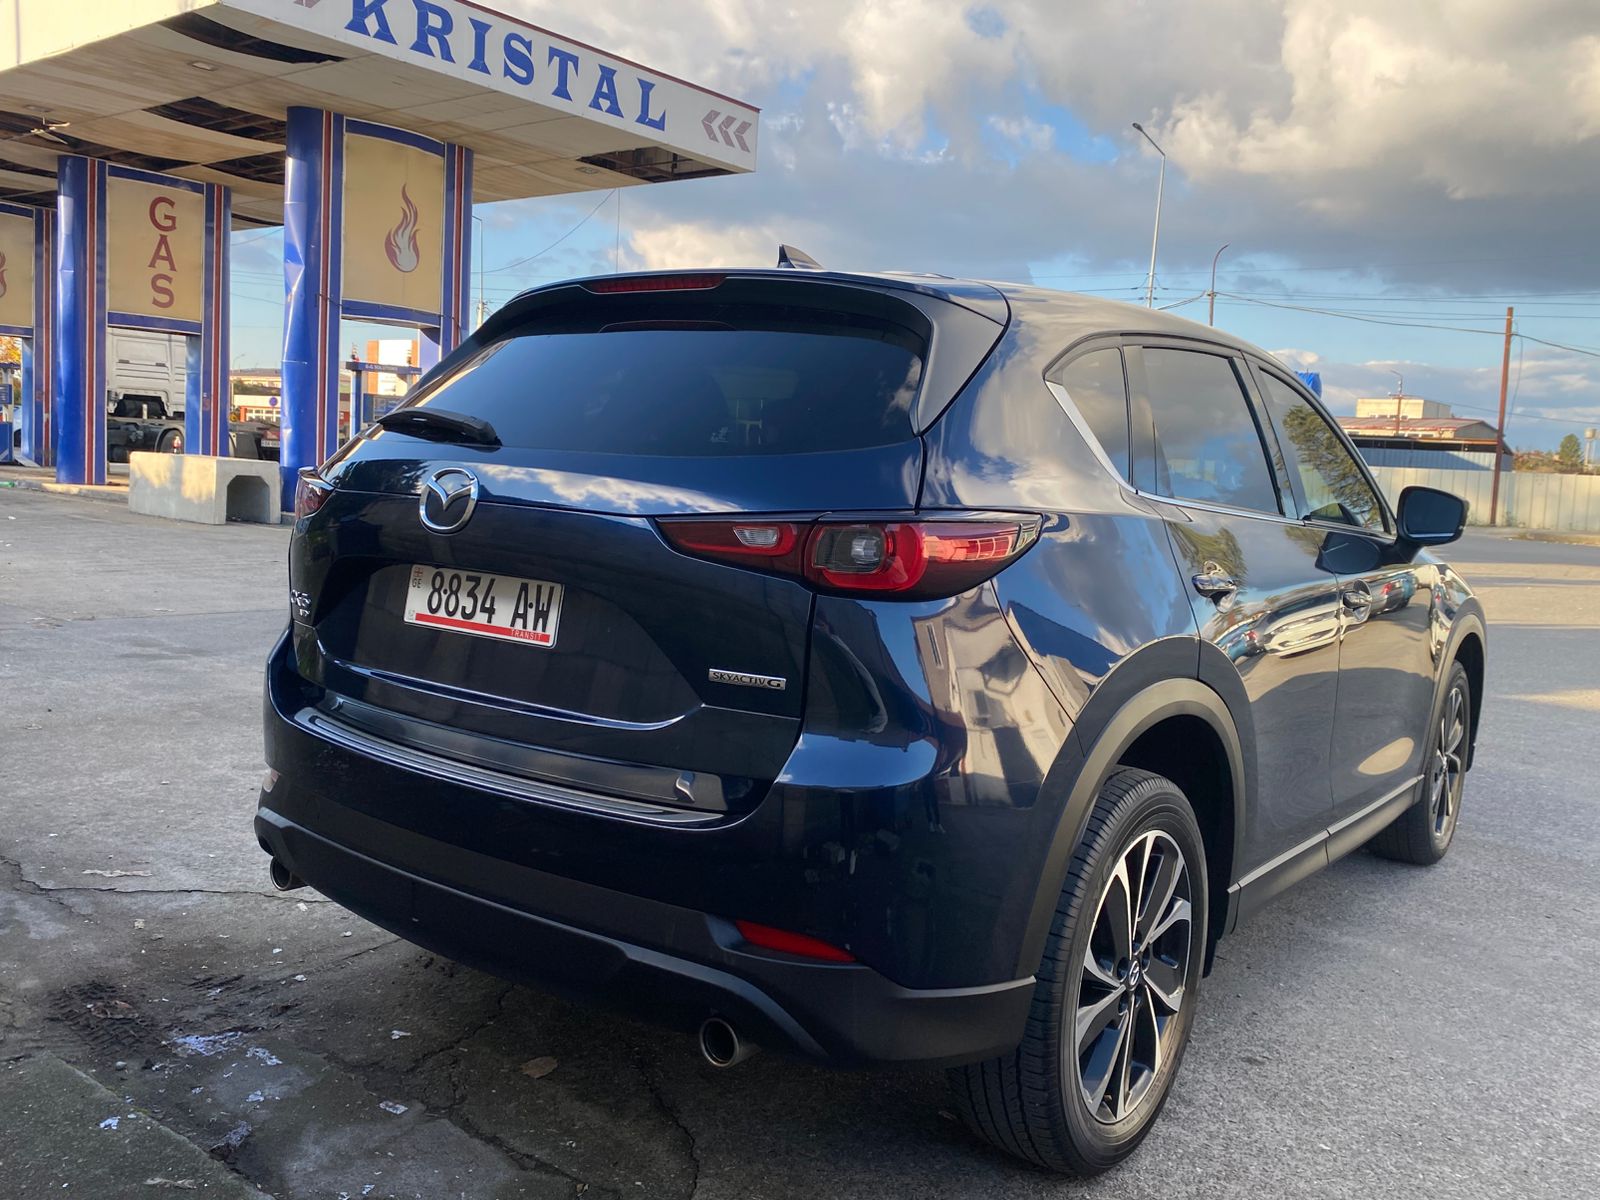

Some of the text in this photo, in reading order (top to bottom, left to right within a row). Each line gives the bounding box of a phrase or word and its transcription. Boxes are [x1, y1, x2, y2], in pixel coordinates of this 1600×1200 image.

[344, 0, 666, 132] KRISTAL
[148, 196, 177, 308] GAS
[511, 629, 541, 641] TRANSIT
